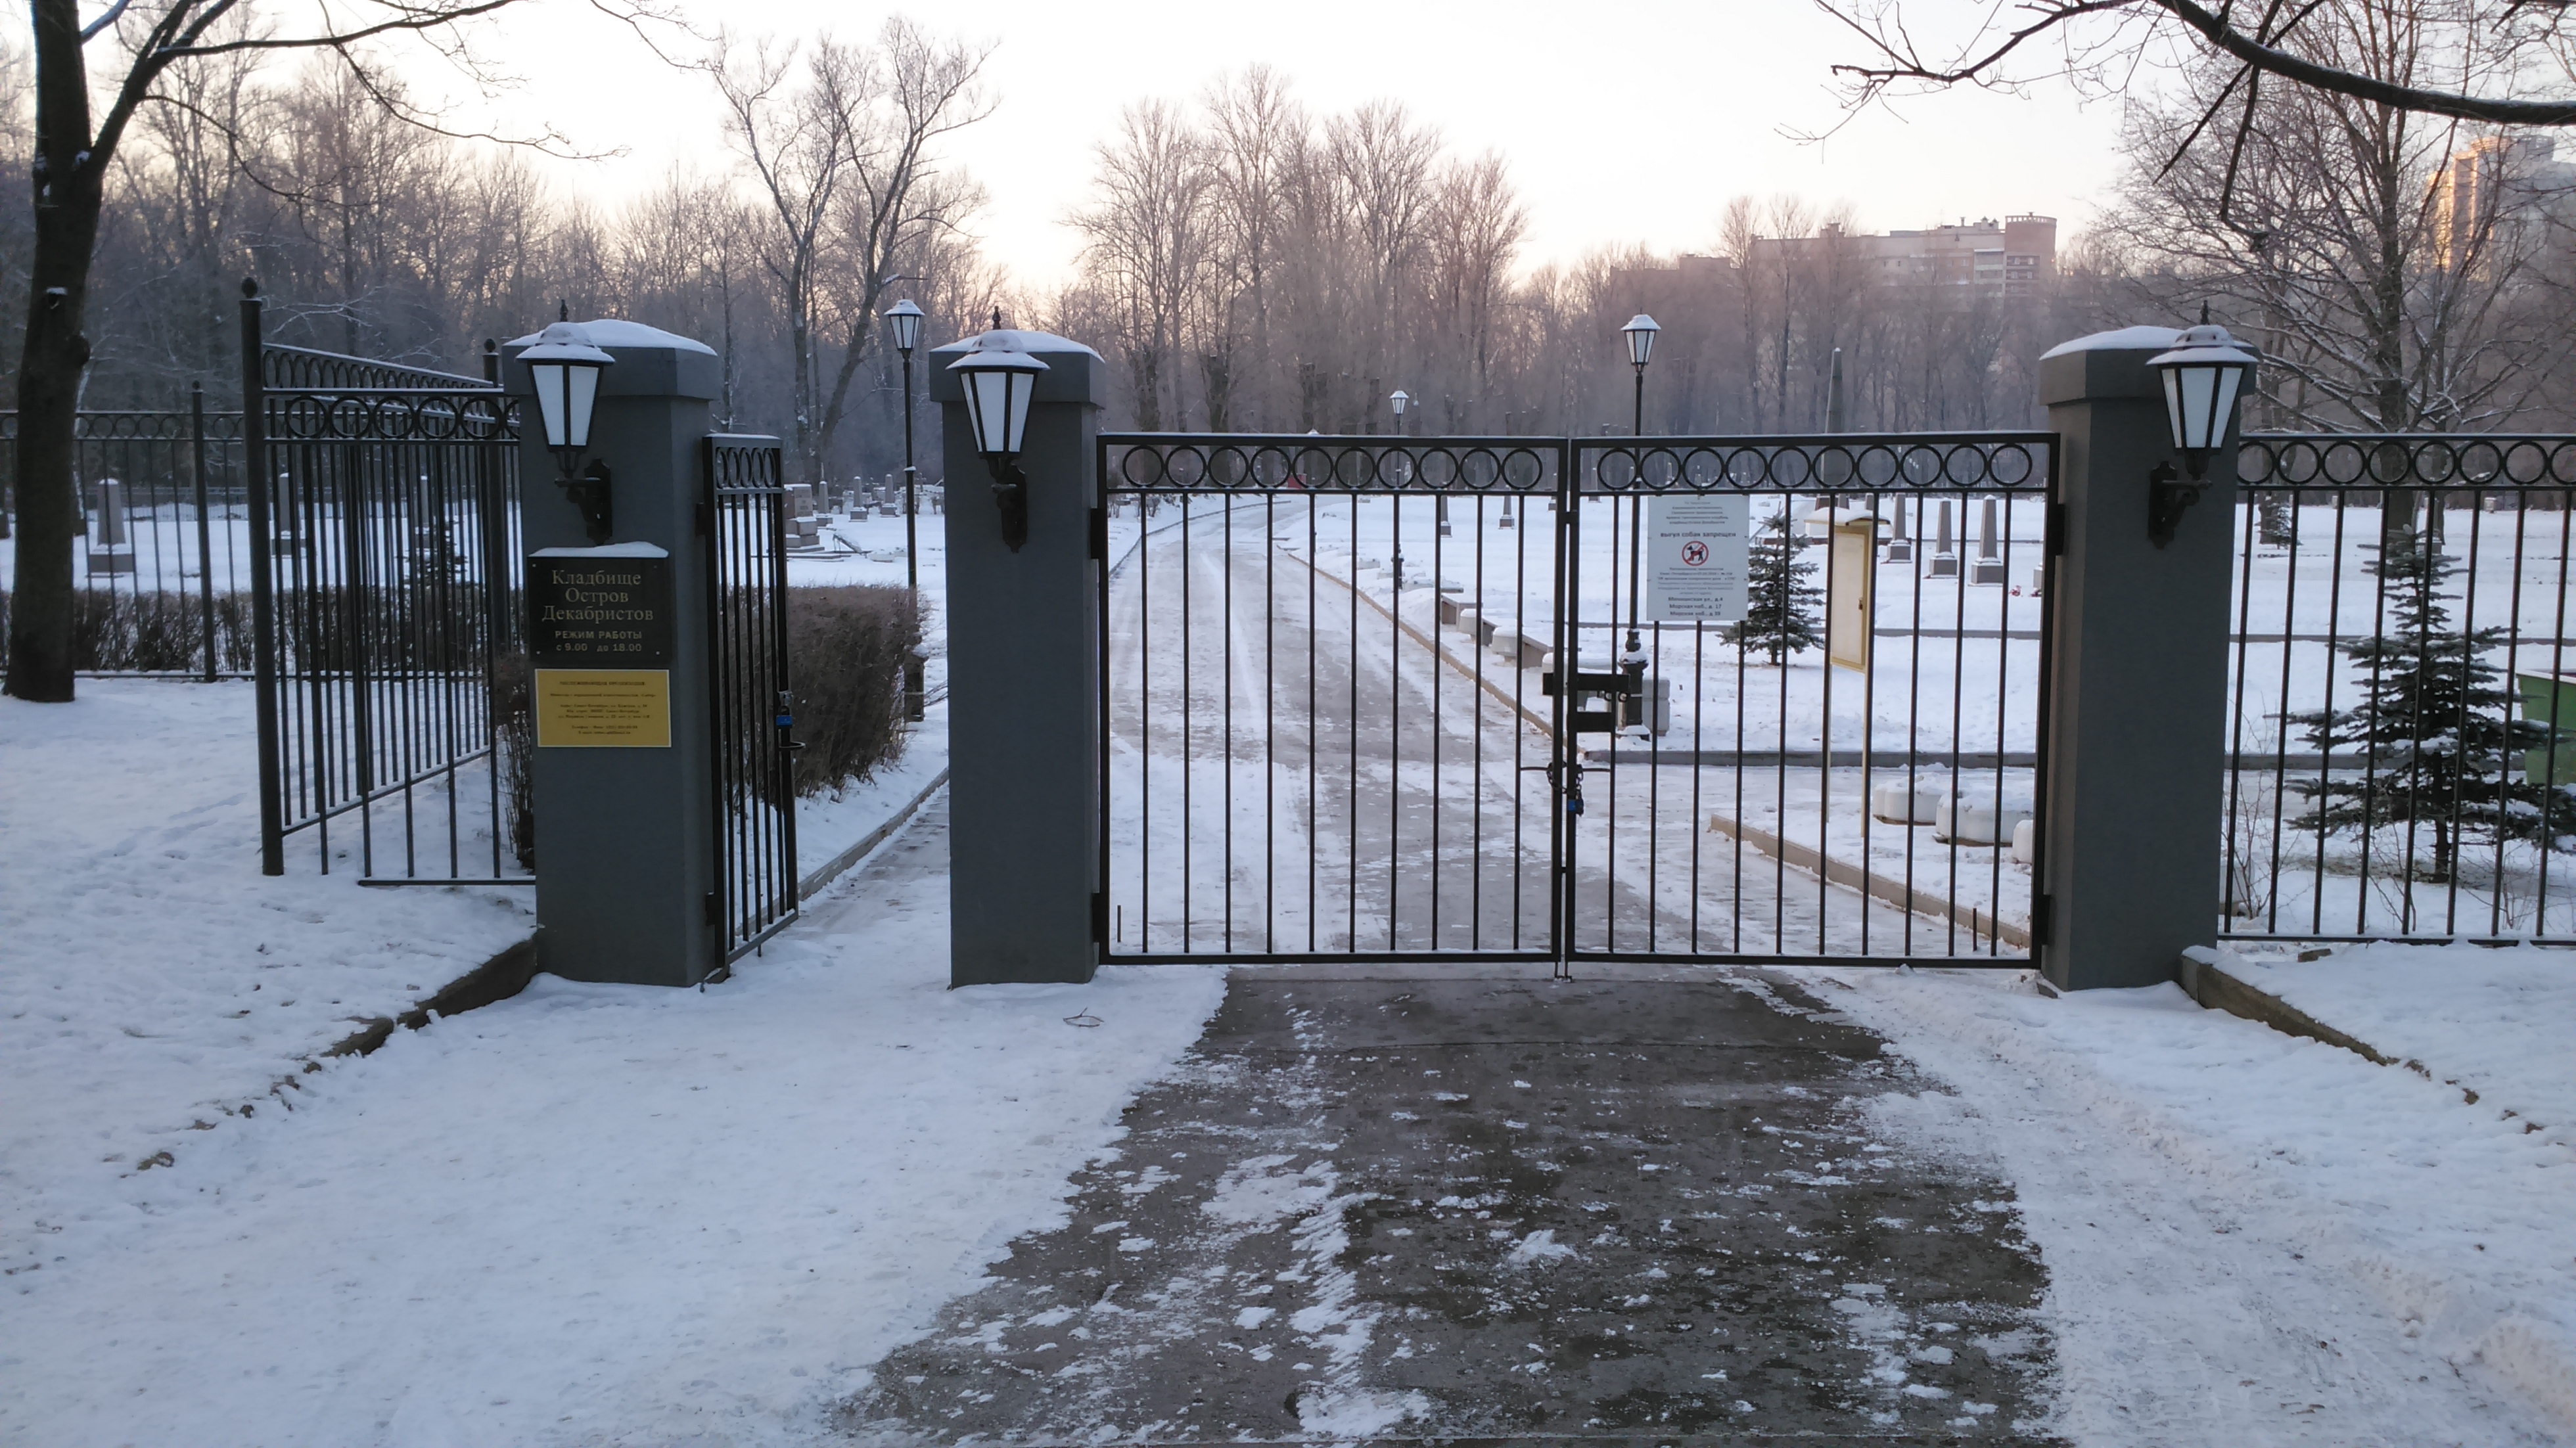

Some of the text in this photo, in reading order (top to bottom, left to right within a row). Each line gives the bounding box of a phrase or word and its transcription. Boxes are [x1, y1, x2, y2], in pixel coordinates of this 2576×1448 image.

[551, 570, 641, 586] Кладбище
[565, 587, 629, 606] Остров
[541, 605, 653, 624] Декабристов
[555, 630, 642, 639] РЕЖИМ РАБОТЫ
[564, 643, 588, 652] 9.00
[612, 643, 642, 652] 18.00
